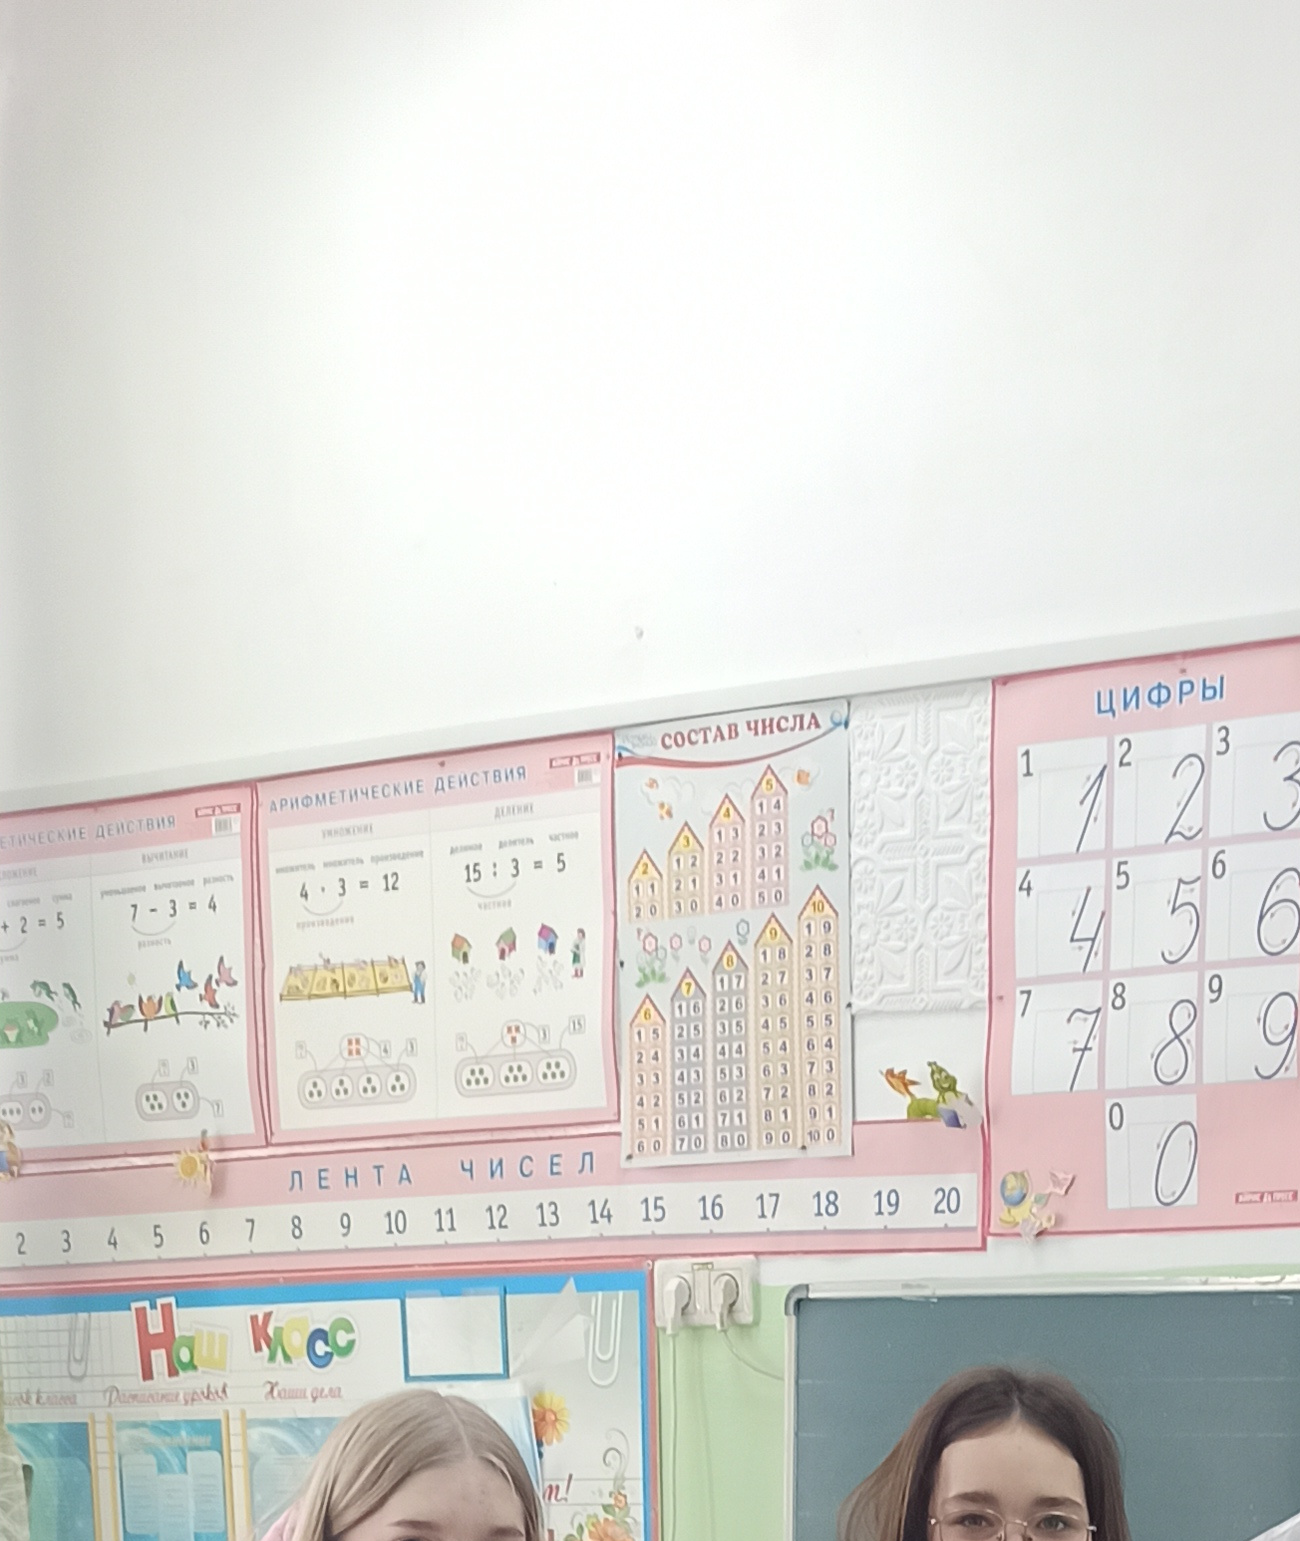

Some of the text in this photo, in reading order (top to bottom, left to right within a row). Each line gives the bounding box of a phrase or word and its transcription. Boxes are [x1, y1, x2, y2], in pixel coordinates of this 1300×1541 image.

[1097, 675, 1224, 718] ЦИФРЫ
[661, 723, 739, 750] СОСТАВ
[746, 712, 821, 736] ЧИСЛА
[1216, 725, 1230, 756] 3
[1021, 749, 1033, 777] 1
[1119, 737, 1132, 768] 2
[270, 779, 423, 812] АРИФМЕТИЧЕСКИЕ
[434, 766, 526, 794] ДЕЙСТВИЯ
[766, 778, 773, 791] 5
[758, 799, 781, 814] 1 4
[1077, 764, 1107, 853] 1
[1165, 753, 1205, 844] 2
[494, 803, 534, 820] ДЕЛЕНИЕ
[723, 807, 731, 819] 4
[95, 815, 175, 840] ДЕЙСТВИЯ
[717, 827, 739, 843] 1 3
[758, 822, 781, 837] 2 3
[683, 835, 690, 848] 3
[759, 844, 782, 860] 3 2
[465, 862, 481, 883] 15
[511, 858, 520, 878] 3
[557, 852, 566, 873] 5
[642, 862, 648, 875] 2
[676, 855, 697, 870] 1 2
[716, 850, 739, 865] 2 2
[1212, 849, 1226, 879] 6
[300, 883, 308, 901] 4
[338, 878, 346, 897] 3
[383, 872, 399, 892] 12
[675, 877, 696, 892] 2 1
[716, 872, 738, 886] 3 1
[758, 867, 781, 881] 4 1
[1018, 869, 1032, 897] 4
[1116, 860, 1130, 890] 5
[635, 882, 655, 896] 1 1
[715, 894, 739, 908] 4 0
[758, 889, 782, 904] 5 0
[130, 904, 138, 922] 7
[169, 899, 177, 918] 3
[208, 895, 217, 912] 4
[635, 904, 657, 919] 2 0
[675, 899, 698, 914] 3 0
[812, 900, 825, 913] 10
[20, 916, 27, 934] 2
[57, 911, 64, 929] 5
[806, 921, 831, 935] 1 9
[1069, 885, 1106, 973] 4
[1161, 875, 1201, 964] 5
[769, 927, 778, 940] 9
[726, 954, 734, 968] 8
[805, 943, 831, 958] 2 8
[685, 982, 692, 996] 7
[1111, 982, 1126, 1011] 8
[1208, 974, 1223, 1004] 9
[644, 1008, 651, 1021] 6
[1019, 989, 1032, 1017] 7
[1154, 999, 1197, 1085] 8
[1255, 992, 1299, 1079] 9
[1066, 1006, 1102, 1092] 7
[1109, 1102, 1124, 1131] 0
[289, 1151, 594, 1191] ЛЕНТА ЧИСЕЛ
[1155, 1120, 1198, 1206] 0
[16, 1187, 960, 1255] 2 3 4 5 6 7 8 9 10 11 12 13 14 15 16 17 18 19 20
[134, 1302, 229, 1382] Наш
